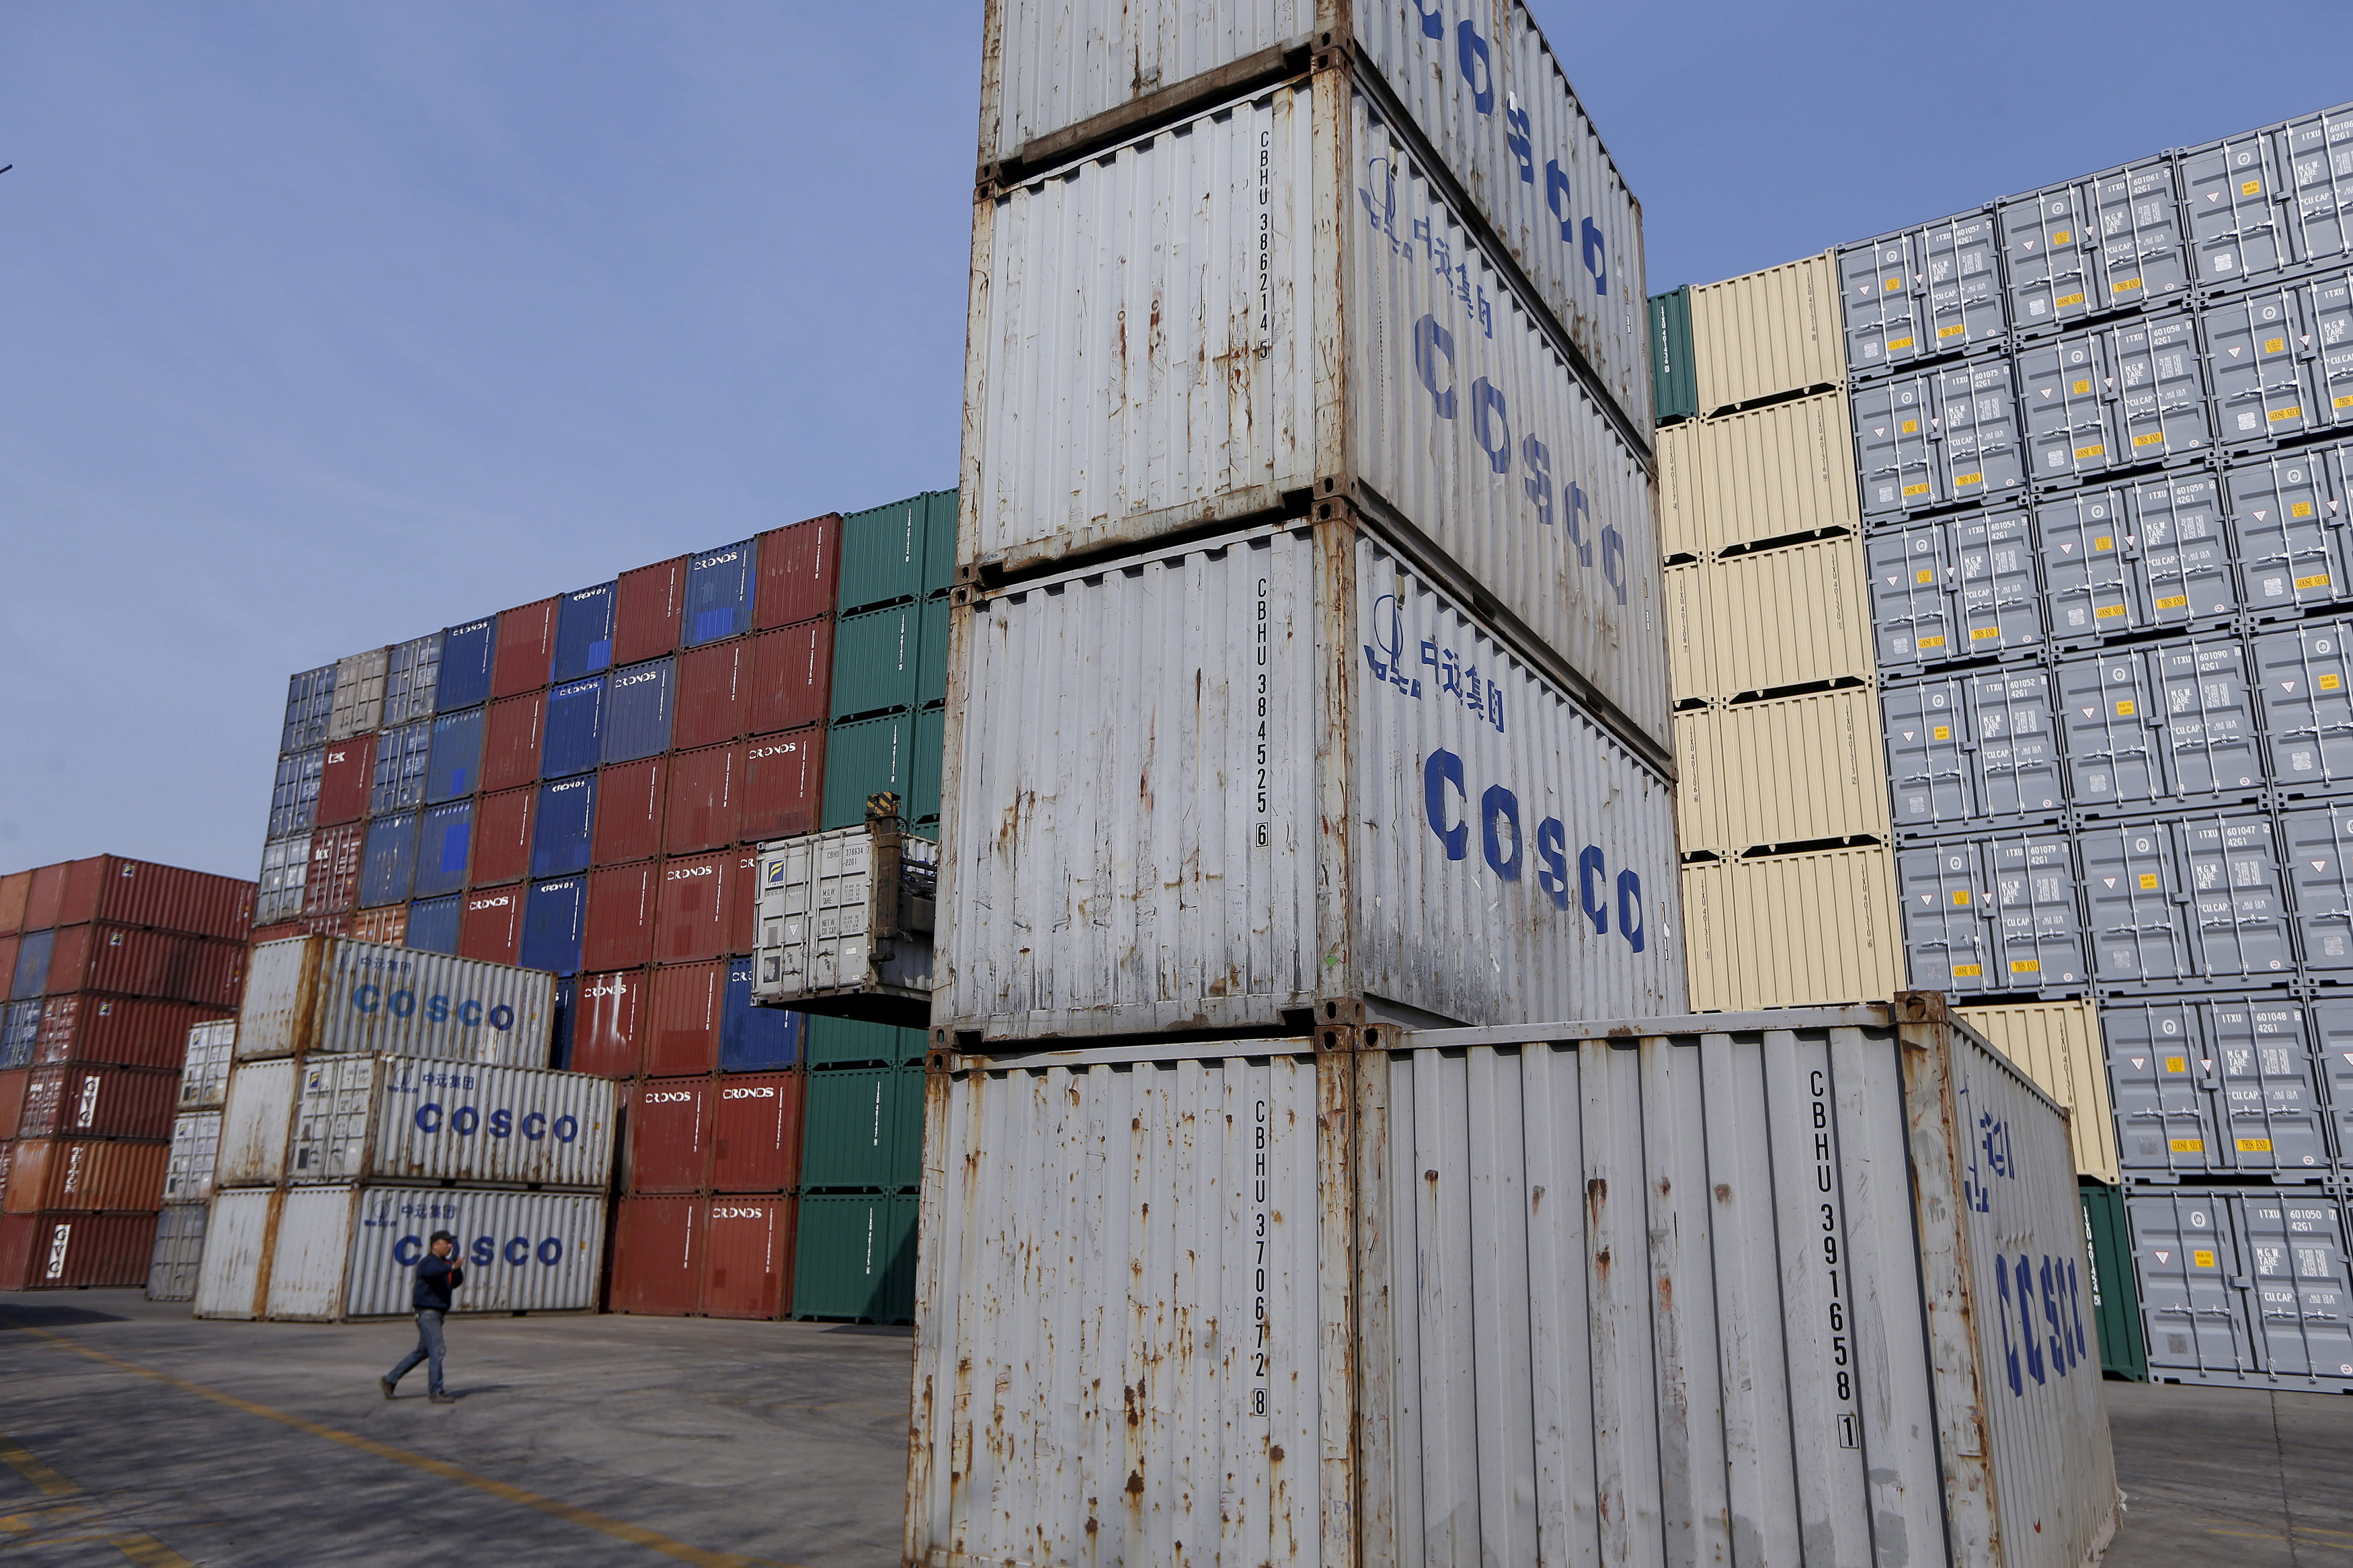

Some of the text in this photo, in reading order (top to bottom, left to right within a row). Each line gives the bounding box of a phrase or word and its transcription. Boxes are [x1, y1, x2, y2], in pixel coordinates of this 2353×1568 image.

[2302, 129, 2321, 141] ITXU
[2331, 131, 2350, 142] 42G1
[2299, 169, 2317, 179] TARE
[2108, 183, 2124, 193] ITXU
[2133, 173, 2159, 185] 601061
[2300, 177, 2313, 185] NET
[2134, 184, 2151, 194] 42G1
[1936, 233, 1950, 242] ITXU
[1957, 224, 1980, 237] 601057
[1259, 131, 1269, 360] CBHU 386214 5
[1957, 236, 1972, 245] 42G1
[2325, 288, 2344, 298] ITXU
[2125, 333, 2143, 343] ITXU
[2153, 324, 2180, 336] 601058
[2326, 328, 2344, 337] TARE
[2154, 335, 2171, 345] 42G1
[2326, 335, 2340, 344] NET
[1952, 376, 1968, 386] ITXU
[1975, 370, 1998, 380] 601075
[1975, 379, 1991, 388] 42G1
[1414, 313, 1628, 606] COSCO
[2149, 490, 2166, 501] ITXU
[2177, 483, 2204, 495] 601059
[2177, 495, 2194, 504] 42G1
[1968, 526, 1984, 536] ITXU
[1991, 520, 2016, 530] 601054
[1991, 531, 2007, 540] 42G1
[694, 551, 737, 571] CRONOS
[2172, 655, 2191, 665] ITXU
[2199, 651, 2227, 662] 601090
[2200, 662, 2219, 671] 42G1
[614, 670, 657, 688] CRONOS
[1420, 632, 1505, 734] 中远集团
[559, 682, 598, 696] CRONOS
[1986, 683, 2002, 693] ITXU
[2010, 679, 2036, 689] 601052
[2011, 689, 2028, 698] 42G1
[1255, 577, 1268, 847] CBHU 384525 6
[748, 742, 796, 760] CRONOS
[2199, 829, 2218, 839] ITXU
[2227, 825, 2256, 835] 601047
[2228, 837, 2247, 847] 42G1
[827, 851, 840, 859] CBHU
[1424, 746, 1645, 953] COSCO
[2005, 848, 2023, 857] ITXU
[2030, 845, 2056, 855] 601079
[2031, 856, 2048, 864] 42G1
[667, 865, 712, 880] CRONOS
[470, 895, 509, 910] CRONOS
[353, 984, 514, 1031] COSCO
[2222, 1014, 2241, 1023] ITXU
[2257, 1012, 2286, 1022] 601048
[2258, 1024, 2277, 1033] 42G1
[422, 1073, 475, 1091] 中远集团
[645, 1091, 691, 1104] CRONOS
[723, 1086, 774, 1100] CRONOS
[415, 1102, 579, 1143] COSCO
[713, 1206, 762, 1219] CRONOS
[2259, 1209, 2280, 1219] ITXU
[2290, 1210, 2321, 1219] 601050
[2292, 1222, 2312, 1231] 42G1
[1254, 1100, 1267, 1415] CBHU 370672 8
[1810, 1070, 1858, 1448] CBHU 391658 1
[2083, 1206, 2101, 1306] ITXU 401454 5
[2258, 1257, 2278, 1266] TARE
[2259, 1266, 2273, 1274] NET
